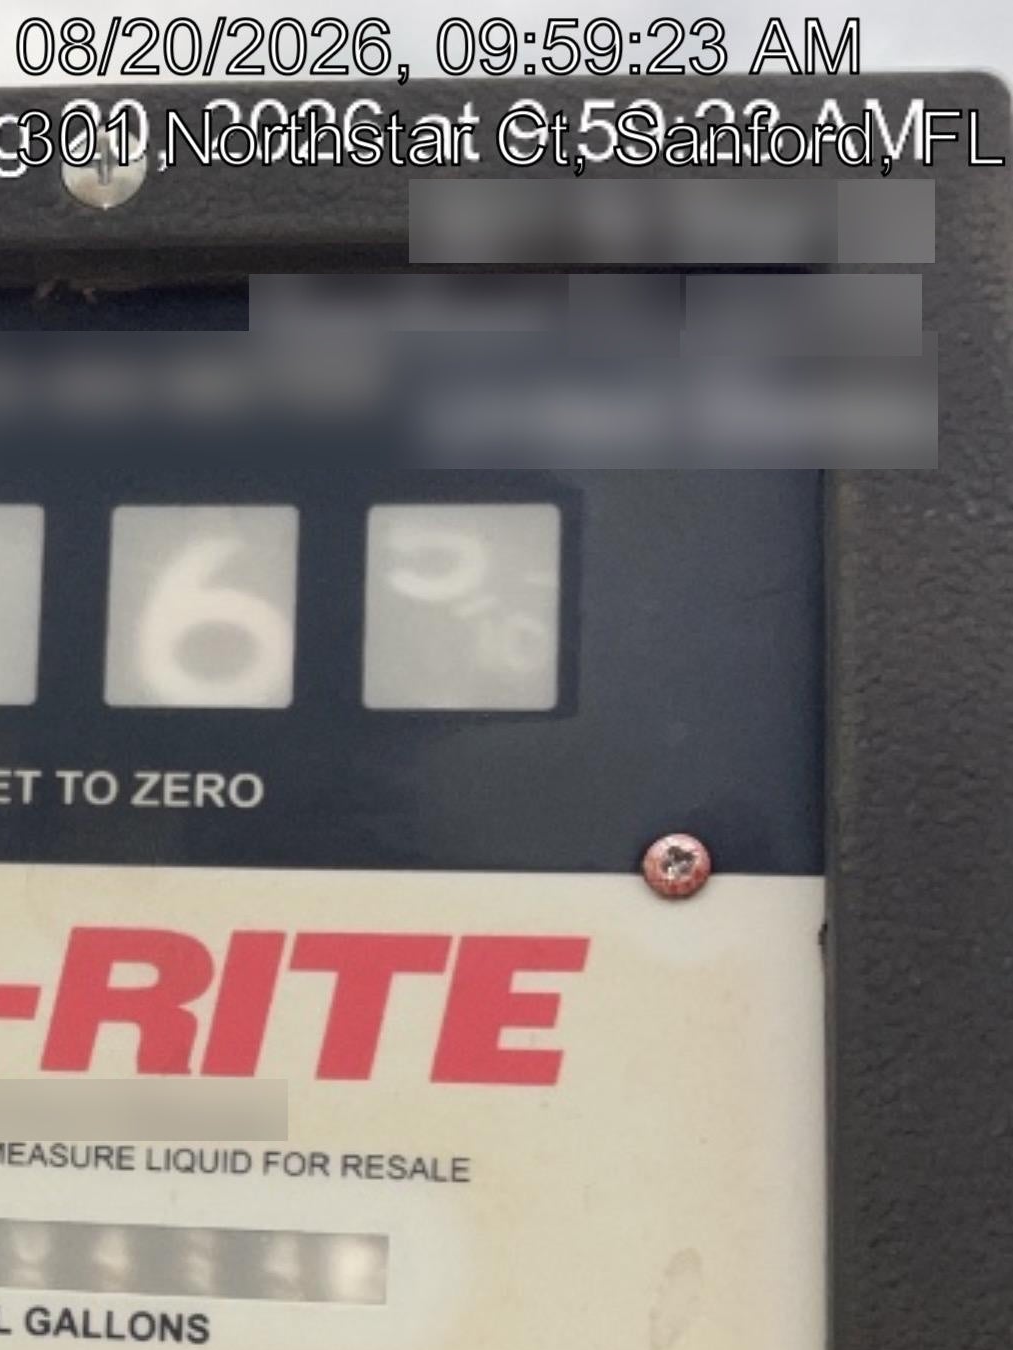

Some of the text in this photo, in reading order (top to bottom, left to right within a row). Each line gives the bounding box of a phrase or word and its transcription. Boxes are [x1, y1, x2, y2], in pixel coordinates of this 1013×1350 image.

[55, 770, 118, 807] TO
[130, 770, 266, 811] ZERO
[145, 1146, 254, 1175] LIQUID
[262, 1150, 331, 1177] FOR
[340, 1154, 472, 1184] RESALE
[23, 1306, 211, 1345] GALLONS
